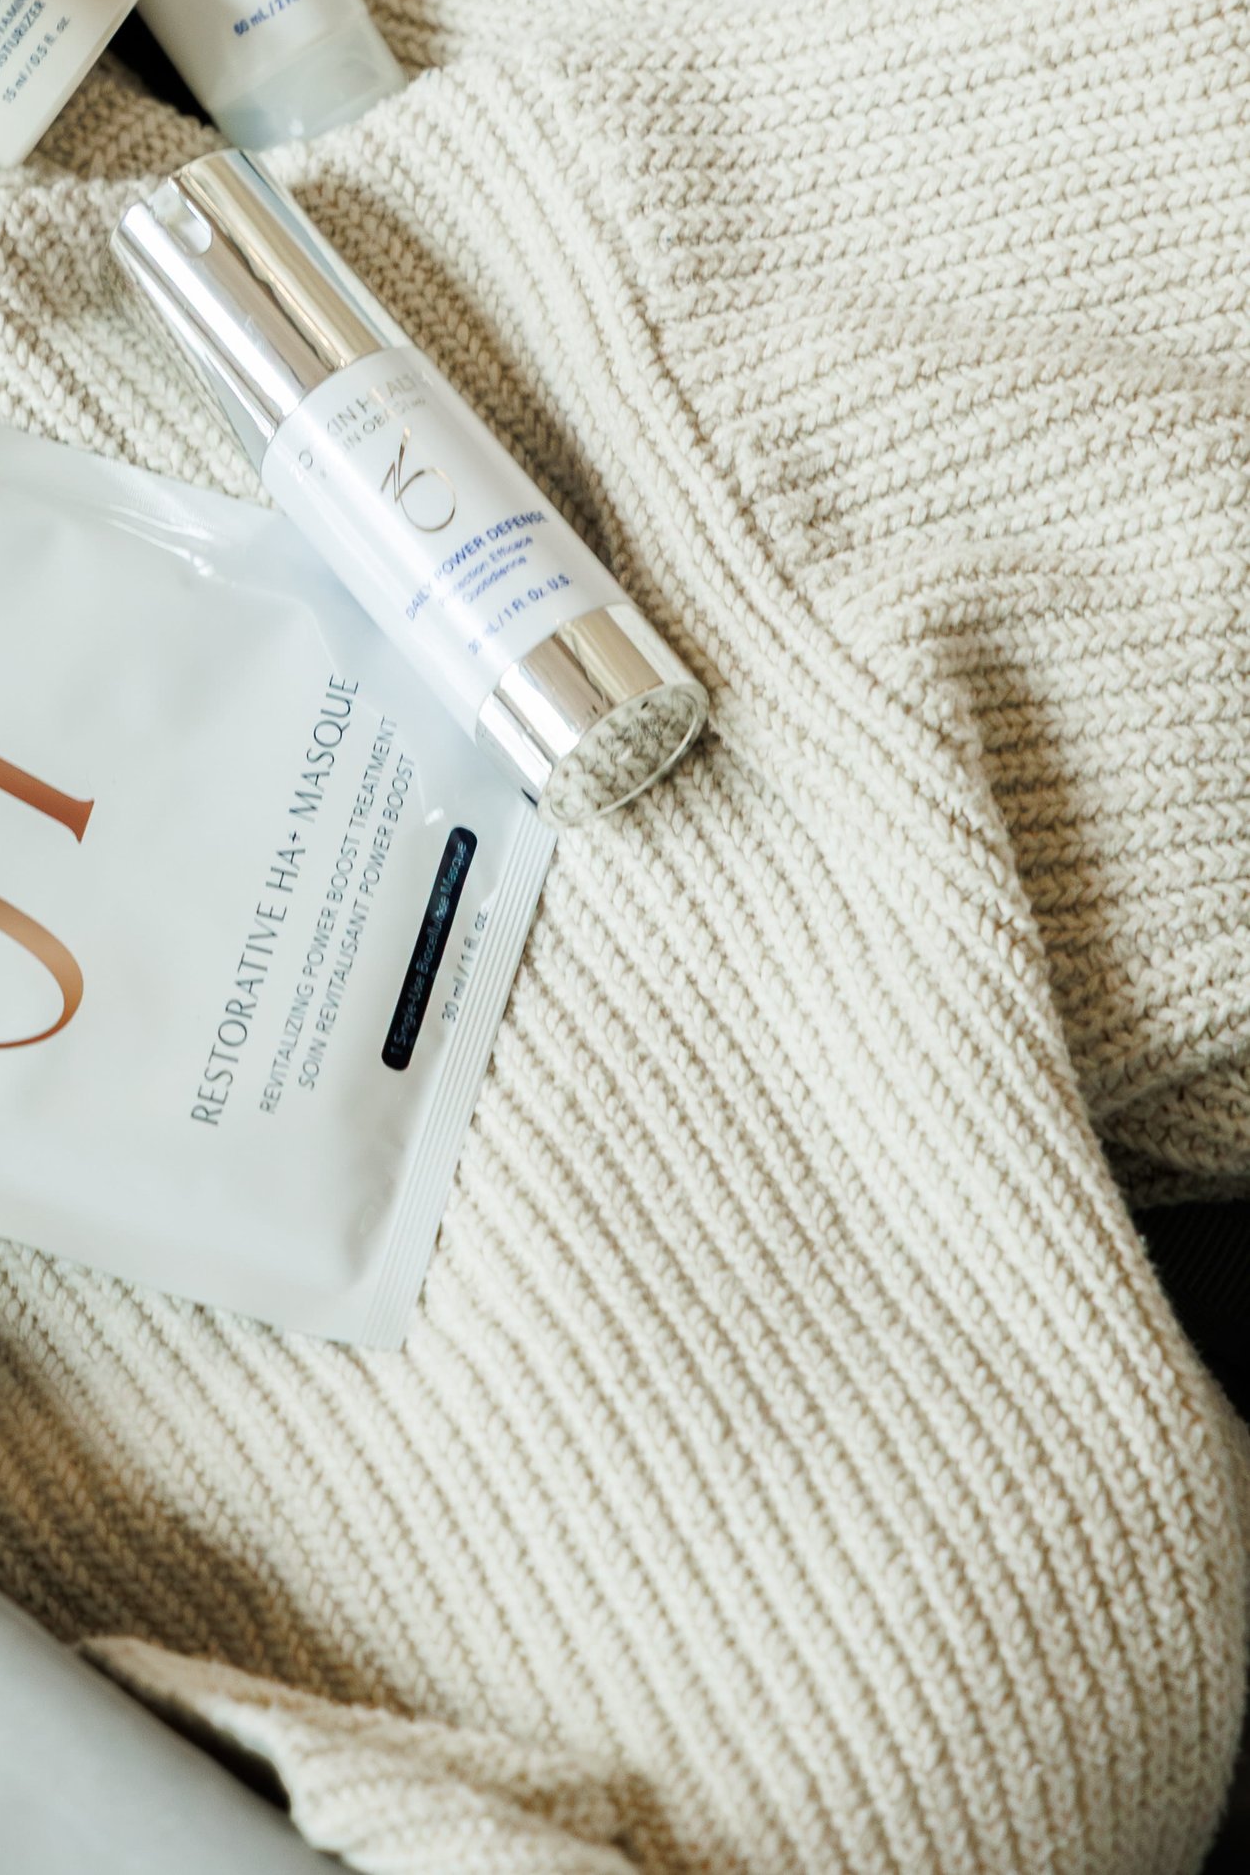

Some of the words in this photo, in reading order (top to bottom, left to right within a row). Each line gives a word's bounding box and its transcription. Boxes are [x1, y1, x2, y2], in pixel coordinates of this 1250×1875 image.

[405, 581, 441, 622] DAILY
[435, 536, 487, 578] POWER
[485, 510, 548, 556] DEFENSE
[189, 901, 288, 1127] RESTORATIVE
[265, 830, 307, 894] HA+
[288, 674, 360, 822] MASQUE
[258, 982, 315, 1115] REVITALIZING
[301, 906, 339, 978] POWER
[325, 833, 360, 904] BOOST
[348, 715, 396, 828] TREATMENT
[297, 1037, 328, 1091] SOIN
[315, 897, 369, 1035] REVITALISANT
[358, 824, 394, 898] POWER
[381, 752, 414, 824] BOOST
[393, 974, 426, 1047] Single-Use
[415, 895, 450, 975] Biocellulose
[439, 838, 468, 895] Masque
[441, 1000, 460, 1023] 30
[452, 976, 465, 999] ml
